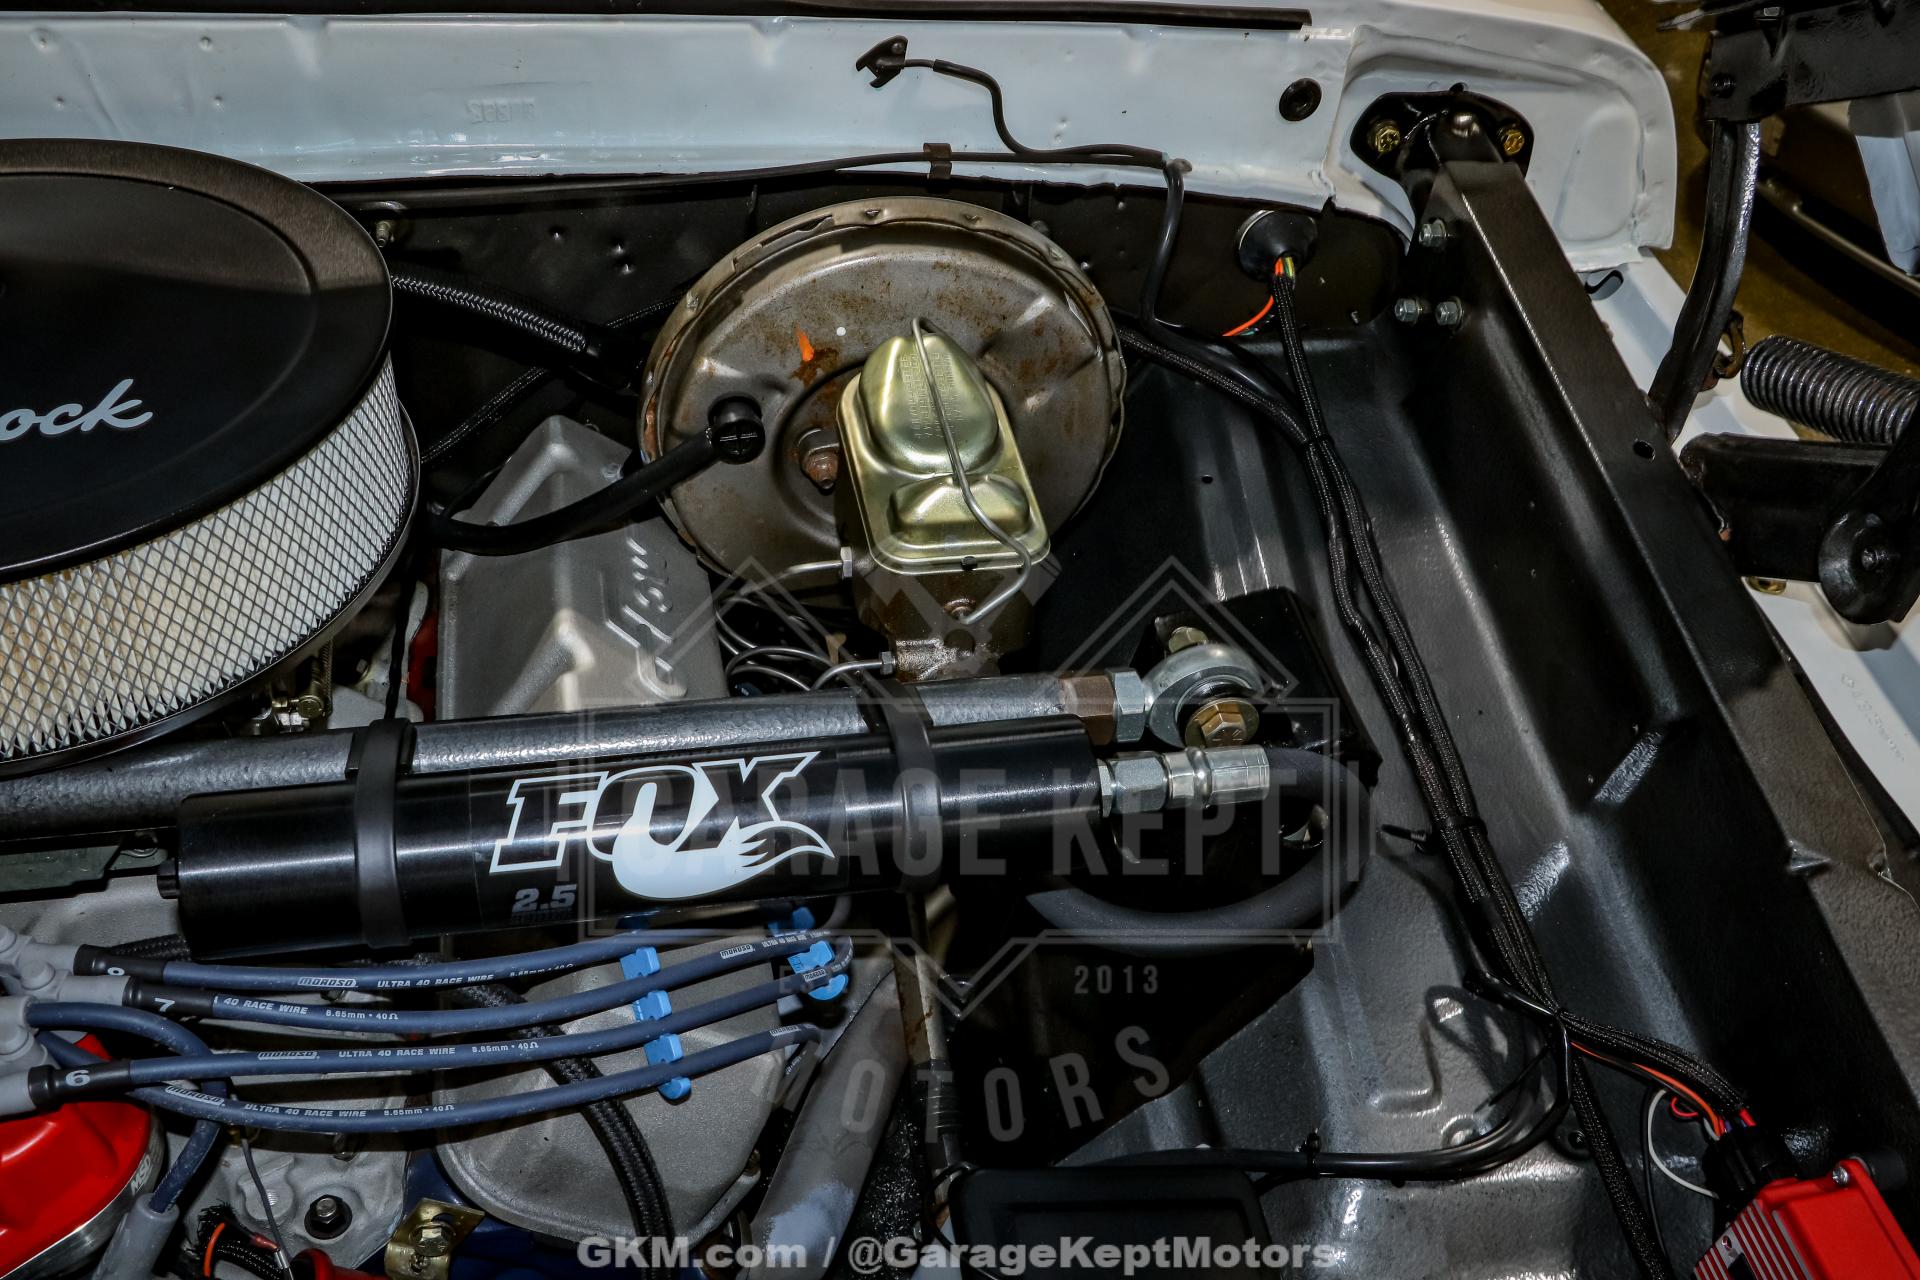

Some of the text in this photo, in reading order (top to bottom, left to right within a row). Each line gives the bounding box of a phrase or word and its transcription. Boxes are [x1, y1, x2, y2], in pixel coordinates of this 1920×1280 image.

[489, 751, 828, 886] FOX
[511, 884, 577, 912] 2.5
[377, 980, 411, 988] ULTRA
[416, 979, 430, 987] 40
[435, 976, 463, 986] RACE
[467, 974, 494, 983] WIRE
[154, 997, 176, 1013] 7
[223, 997, 238, 1006] 40
[243, 999, 274, 1011] RACE
[279, 1004, 308, 1015] WIRE
[325, 1009, 366, 1020] 8.65mm
[338, 1050, 372, 1058] ULTRA
[378, 1049, 392, 1057] 40
[396, 1049, 424, 1057] RACE
[429, 1047, 456, 1055] WIRE
[65, 1069, 91, 1087] 6
[244, 1103, 281, 1114] ULTRA
[285, 1107, 300, 1115] 40
[304, 1109, 333, 1117] RACE
[338, 1109, 367, 1118] WIRE
[130, 1153, 152, 1195] MSD
